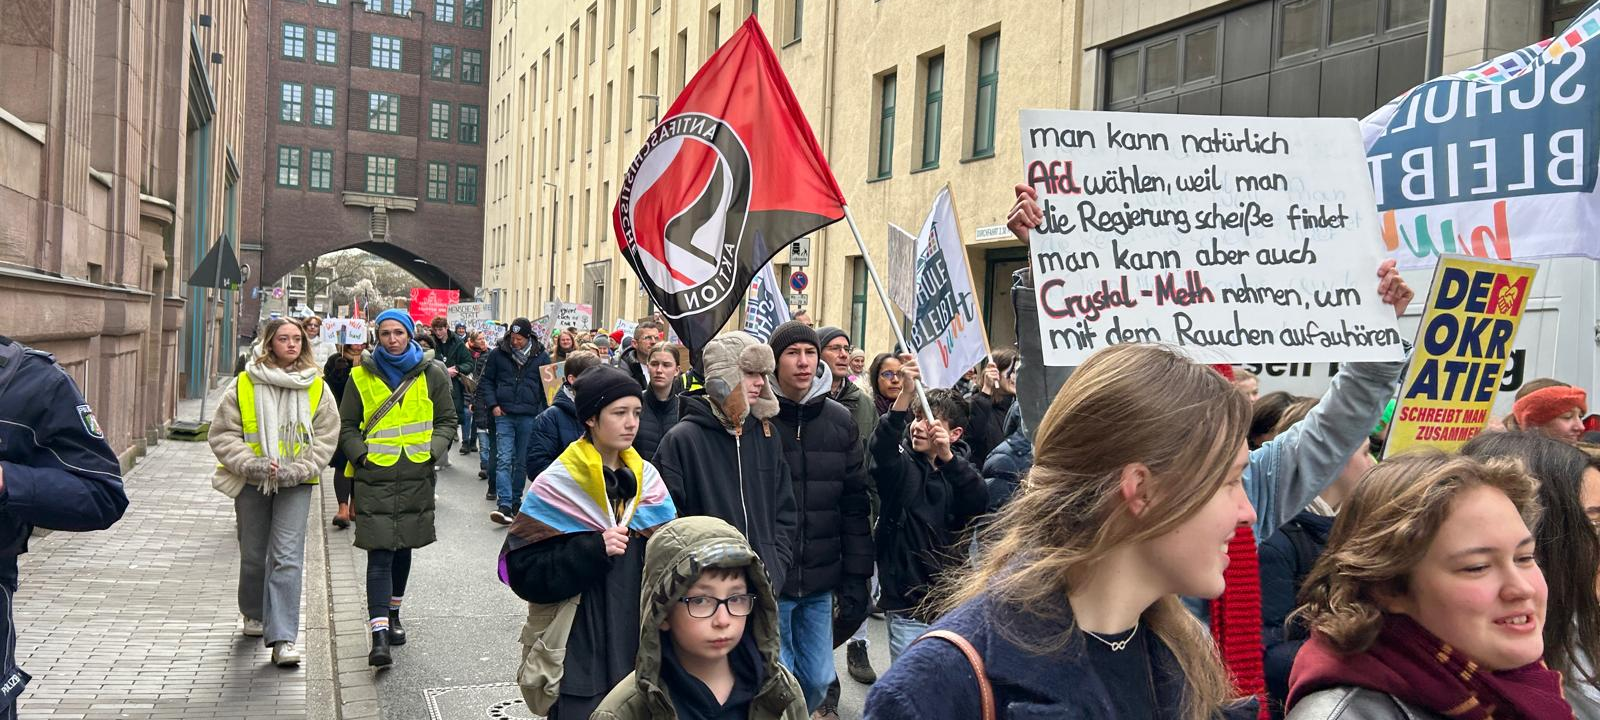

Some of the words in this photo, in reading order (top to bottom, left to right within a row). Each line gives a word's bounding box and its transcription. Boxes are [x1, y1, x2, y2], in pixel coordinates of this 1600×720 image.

[1029, 127, 1096, 149] man
[1106, 121, 1169, 151] kann
[1181, 127, 1289, 154] natürlich
[1083, 164, 1171, 196] wählen,
[1175, 164, 1222, 192] weil
[1235, 172, 1288, 192] man
[1035, 199, 1076, 235] die
[1077, 200, 1191, 235] Regierung
[1195, 202, 1274, 236] scheiße
[1287, 204, 1349, 230] findet
[1037, 250, 1099, 274] man
[1111, 238, 1181, 270] kann
[1196, 237, 1250, 267] aber
[1256, 237, 1317, 265] auch
[917, 258, 948, 305] HULE
[1222, 273, 1310, 310] nehmen,
[1314, 288, 1361, 307] um
[1434, 267, 1530, 317] DEM
[911, 291, 955, 350] BLEIBT
[1050, 319, 1097, 350] mit
[1105, 315, 1161, 346] dem
[1173, 311, 1274, 347] Rauchen
[1424, 313, 1513, 359] OKR
[1405, 358, 1501, 402] ATIE
[1399, 406, 1463, 424] SCHREIBT
[1463, 408, 1488, 424] MAN
